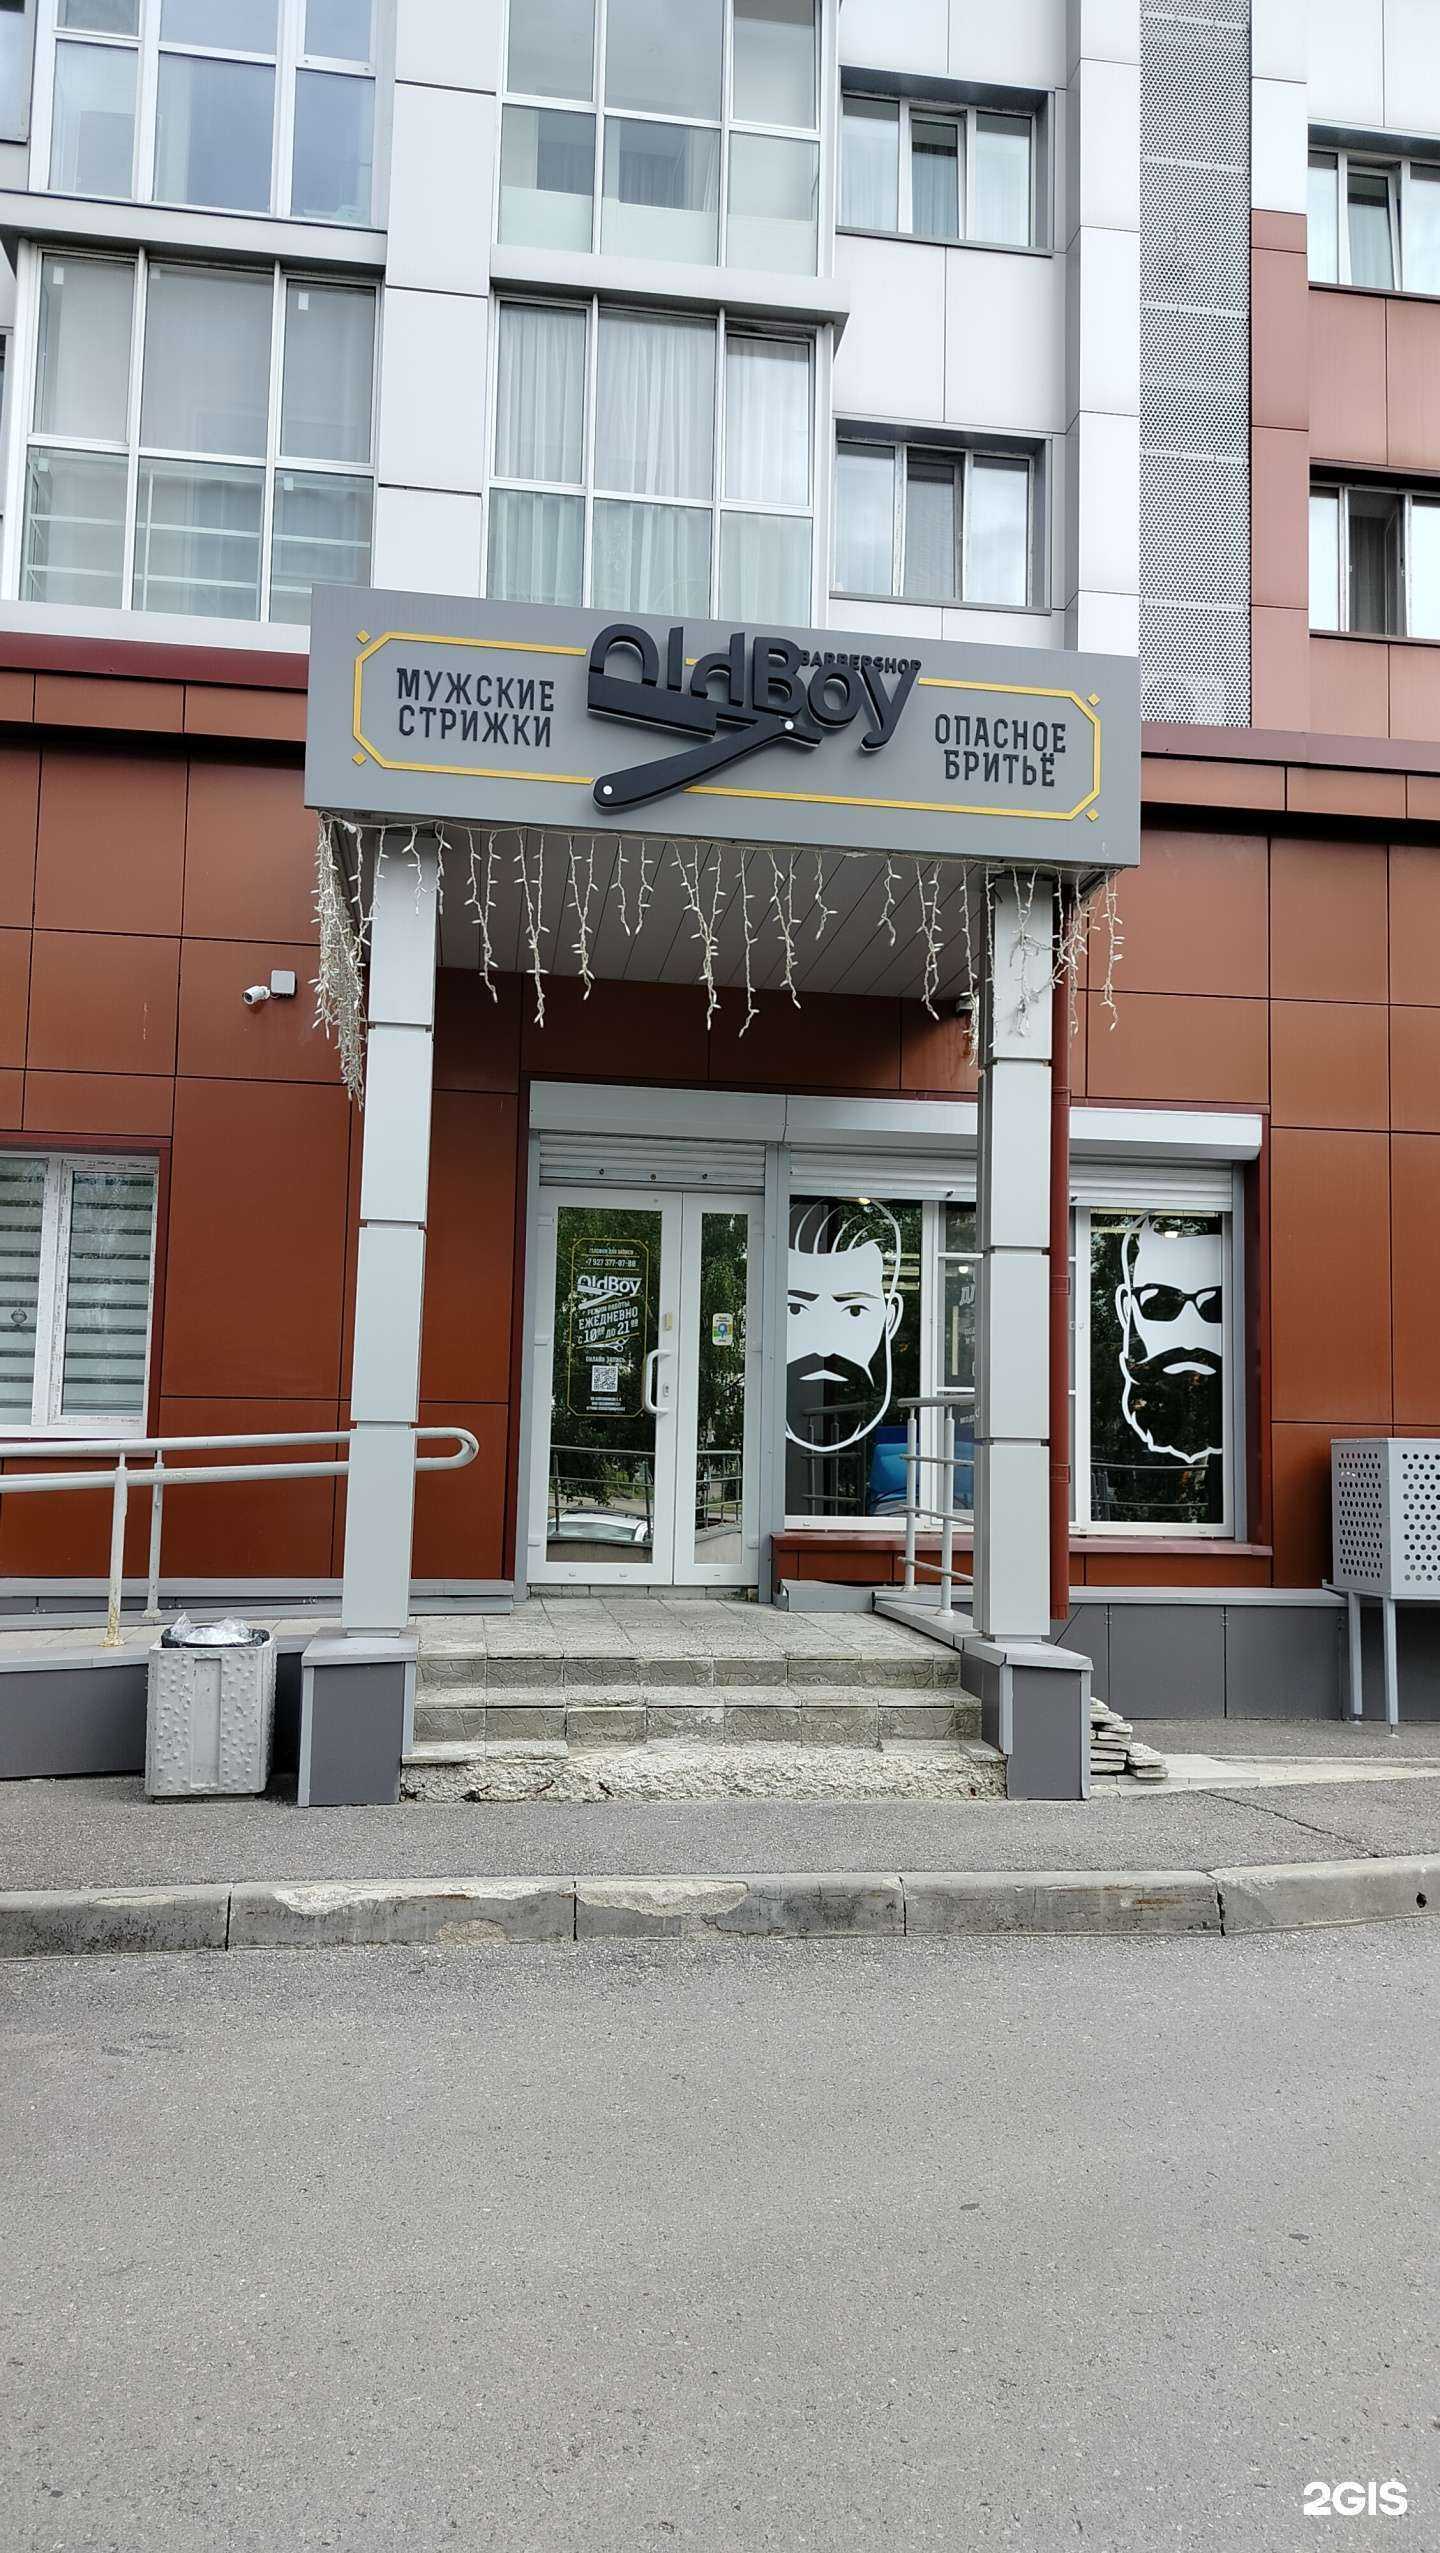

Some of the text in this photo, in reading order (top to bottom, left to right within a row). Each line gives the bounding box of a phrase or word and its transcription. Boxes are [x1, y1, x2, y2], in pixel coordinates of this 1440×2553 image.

[799, 649, 921, 675] BARBERSHOP
[396, 667, 555, 712] МУЖСКИЕ
[587, 623, 921, 750] OldBoy
[399, 704, 551, 748] СТРИЖКИ
[935, 713, 1067, 754] ОПАСНОЕ
[944, 749, 1055, 787] БРИТЬЁ
[576, 1275, 642, 1297] OldBoy
[578, 1306, 639, 1330] ЕЖЕДНЕВНО
[605, 1328, 616, 1339] ДО
